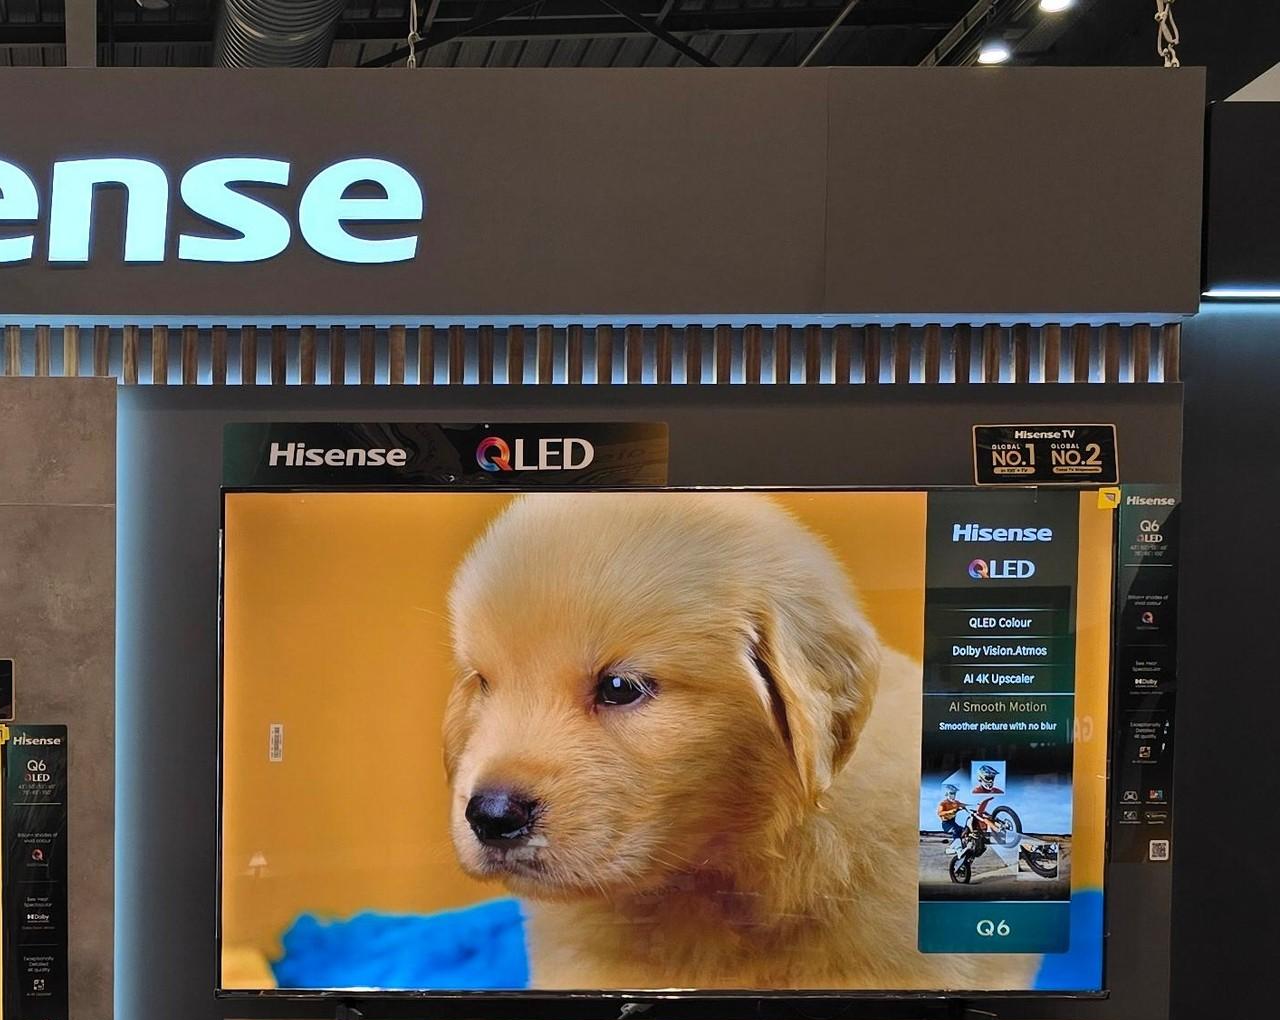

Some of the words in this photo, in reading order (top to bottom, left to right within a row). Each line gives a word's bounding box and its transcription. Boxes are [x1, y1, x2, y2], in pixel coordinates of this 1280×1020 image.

[1014, 430, 1060, 439] Hisense
[1062, 430, 1076, 439] TV
[269, 442, 407, 468] Hisense
[475, 436, 595, 471] QLED
[992, 443, 1036, 466] NO.1
[1051, 443, 1102, 466] NO.2
[1126, 496, 1176, 505] Hisense
[1139, 520, 1160, 532] Q6
[952, 524, 1053, 542] Hisense
[968, 558, 1036, 579] QLED
[969, 618, 997, 629] QLED
[998, 617, 1032, 628] Colour
[952, 645, 982, 658] Dolby
[963, 674, 974, 684] AI
[975, 674, 990, 684] 4K
[991, 673, 1035, 686] Upscaler
[949, 702, 961, 712] AI
[963, 701, 1006, 712] Smooth
[1009, 701, 1048, 712] Motion
[939, 721, 979, 731] Smoother
[979, 721, 1009, 732] picture
[1009, 721, 1028, 731] with
[1028, 722, 1040, 731] no
[1040, 721, 1058, 731] blur
[13, 735, 61, 746] Hisense
[27, 759, 47, 771] Q6
[976, 919, 1011, 936] Q6
